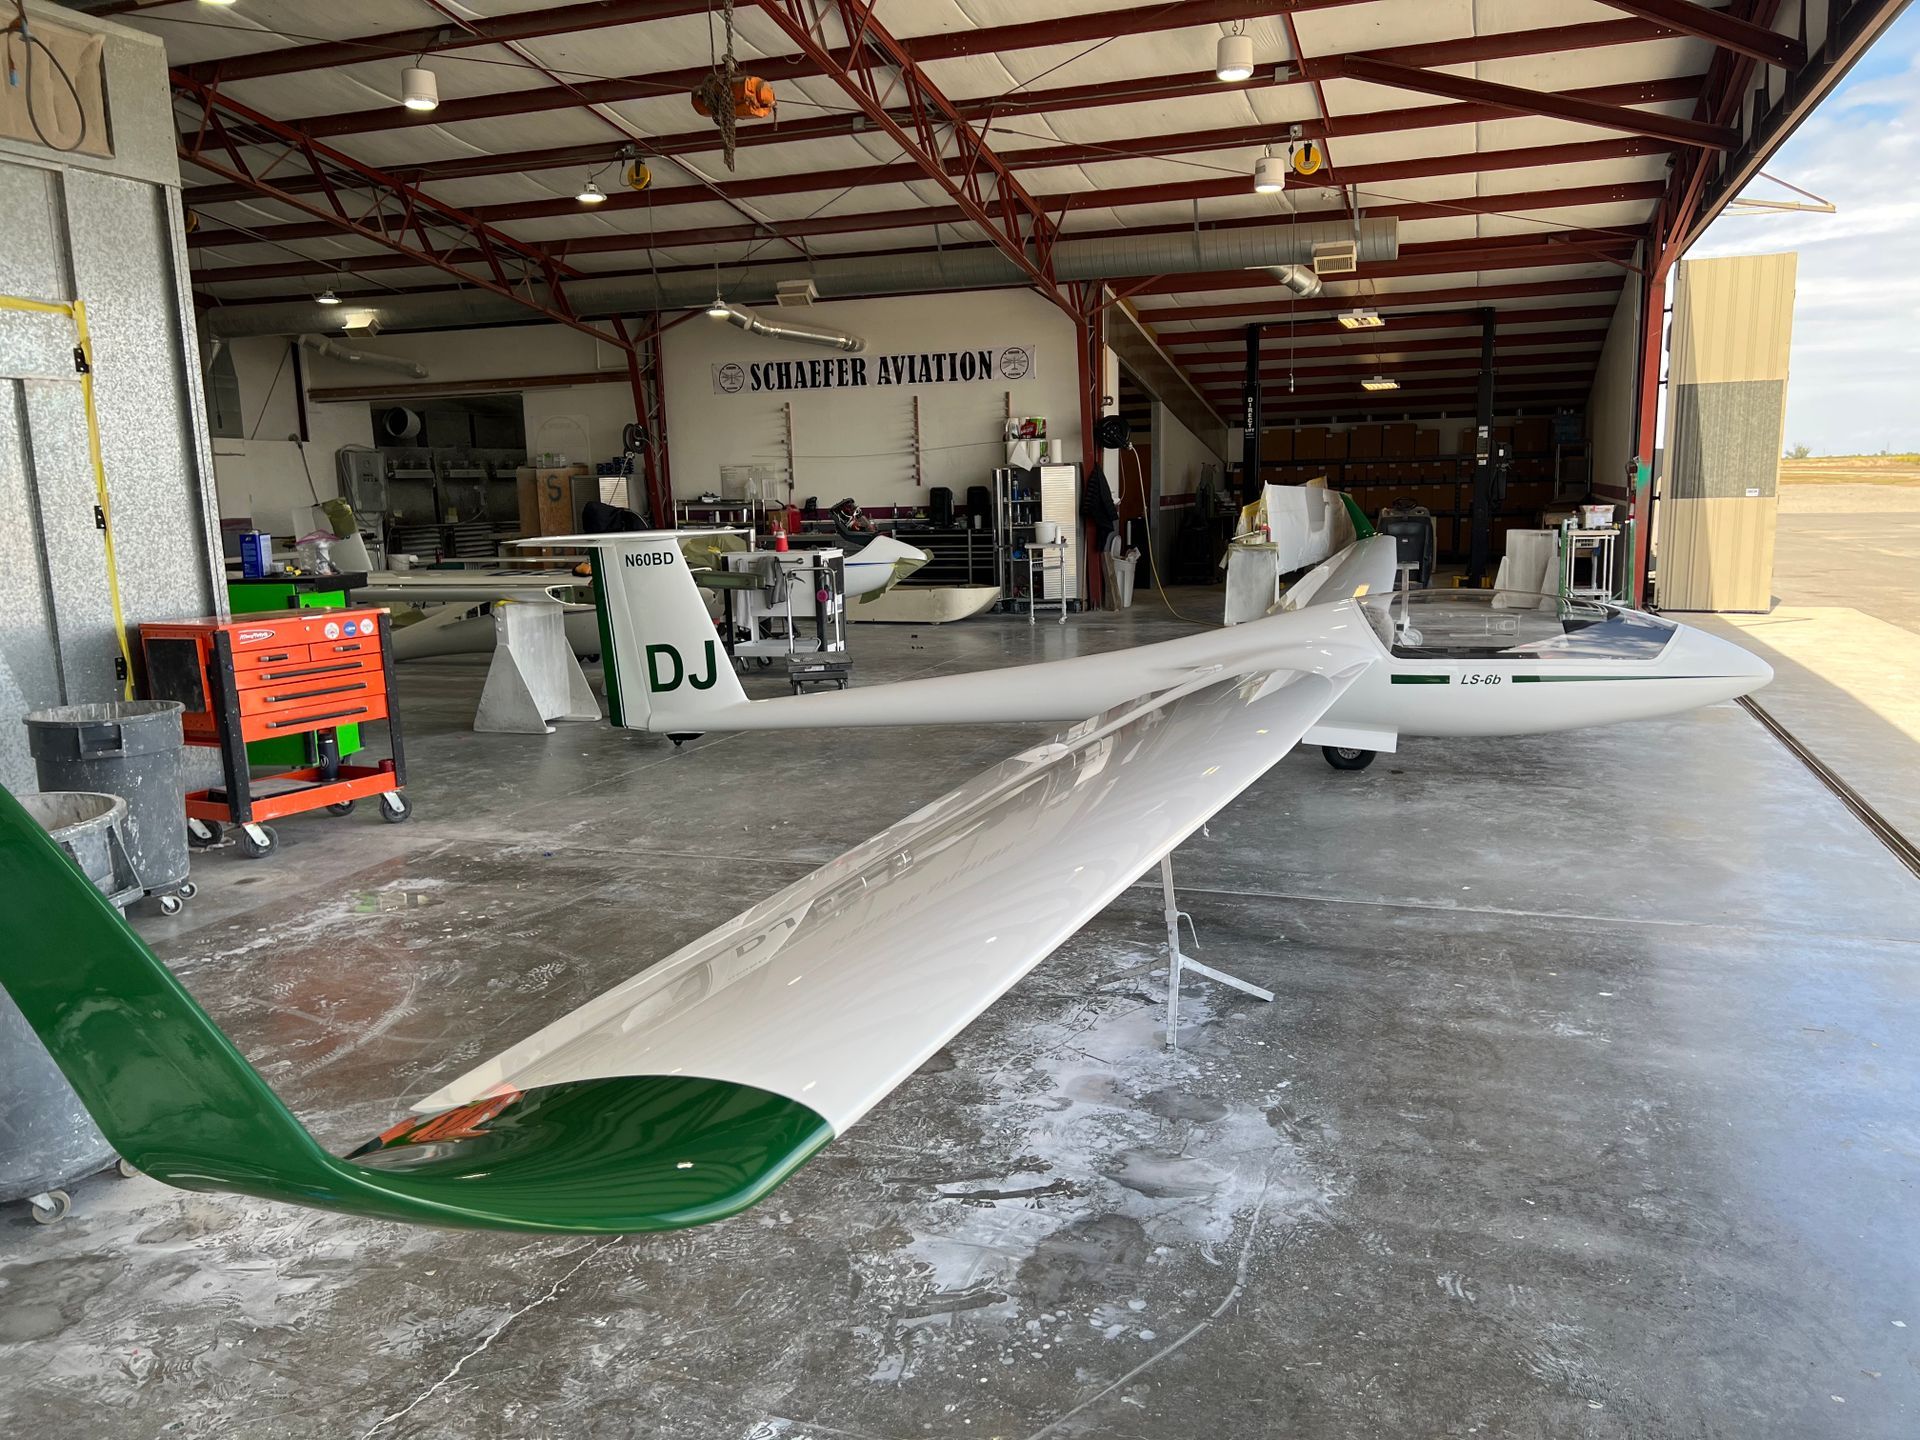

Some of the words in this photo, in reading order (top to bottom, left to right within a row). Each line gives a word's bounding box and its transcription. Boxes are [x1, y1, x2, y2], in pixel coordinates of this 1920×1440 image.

[750, 357, 867, 392] SCHAEFER
[877, 350, 993, 386] AVIATION
[625, 551, 674, 567] N60BD
[645, 639, 718, 693] DJ
[1460, 673, 1502, 685] LS-6b
